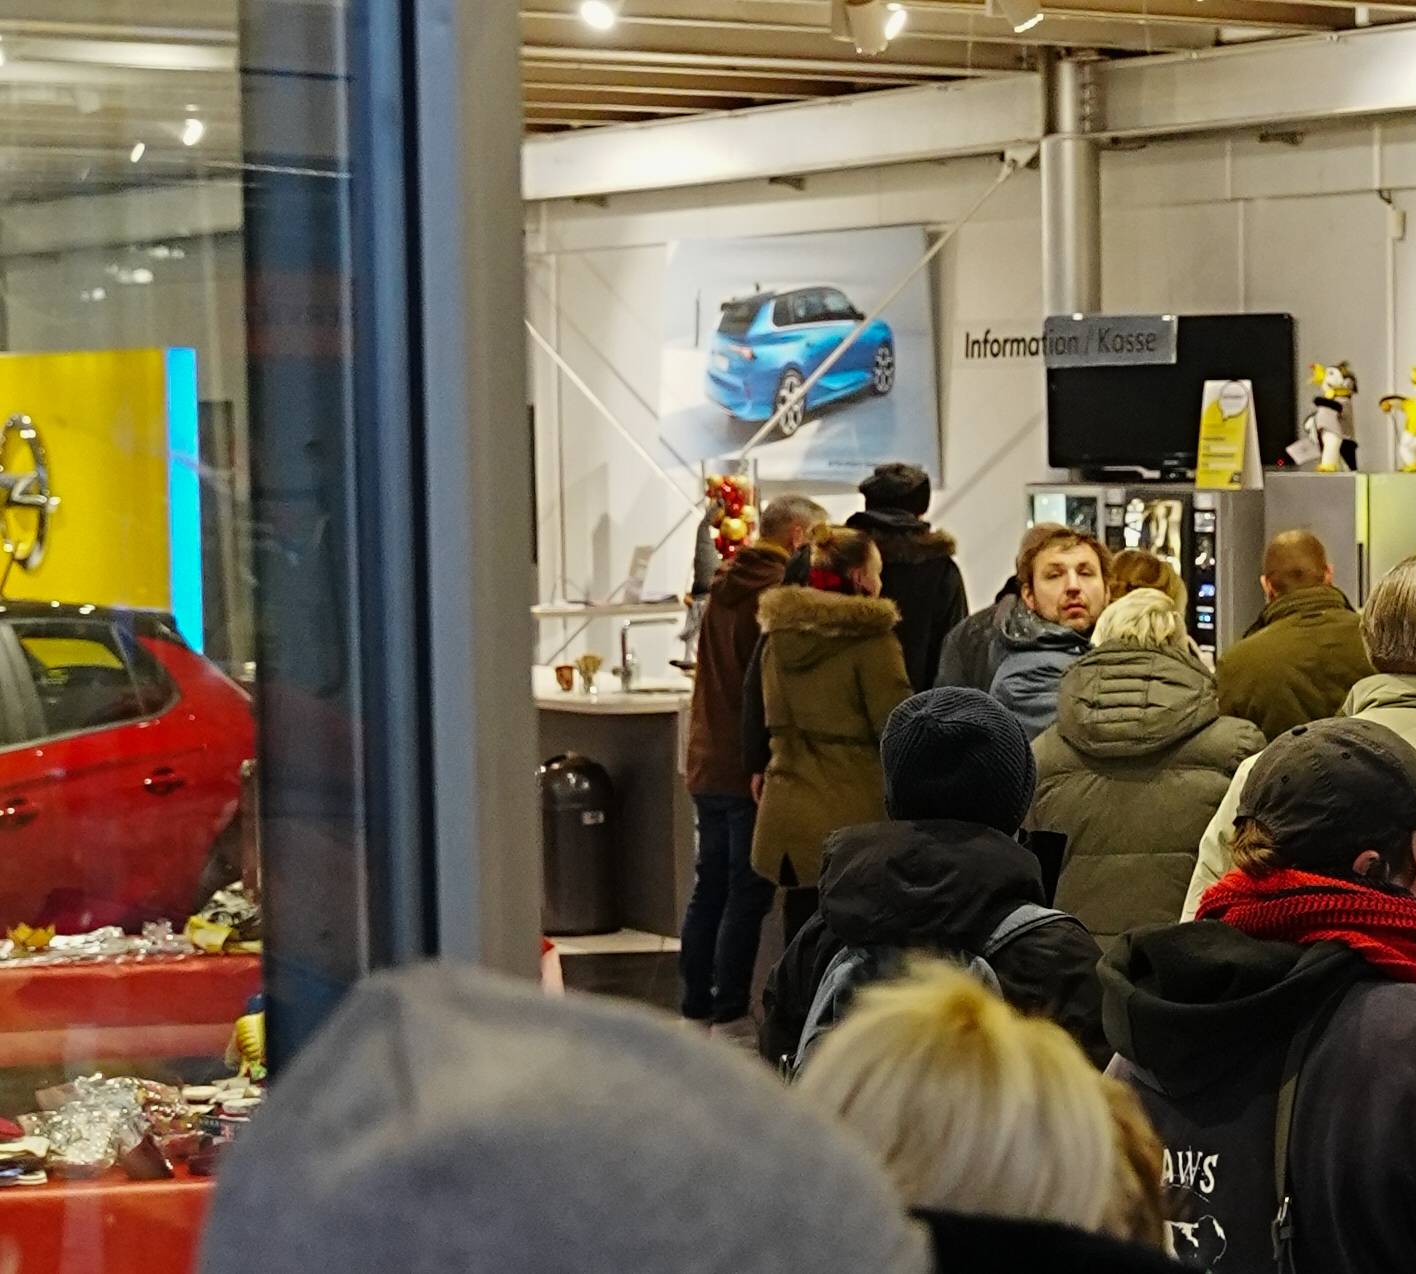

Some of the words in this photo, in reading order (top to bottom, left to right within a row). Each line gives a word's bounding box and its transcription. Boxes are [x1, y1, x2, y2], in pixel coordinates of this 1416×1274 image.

[965, 329, 1079, 359] Information
[1098, 326, 1158, 353] Kasse
[1161, 1147, 1219, 1194] AWS
